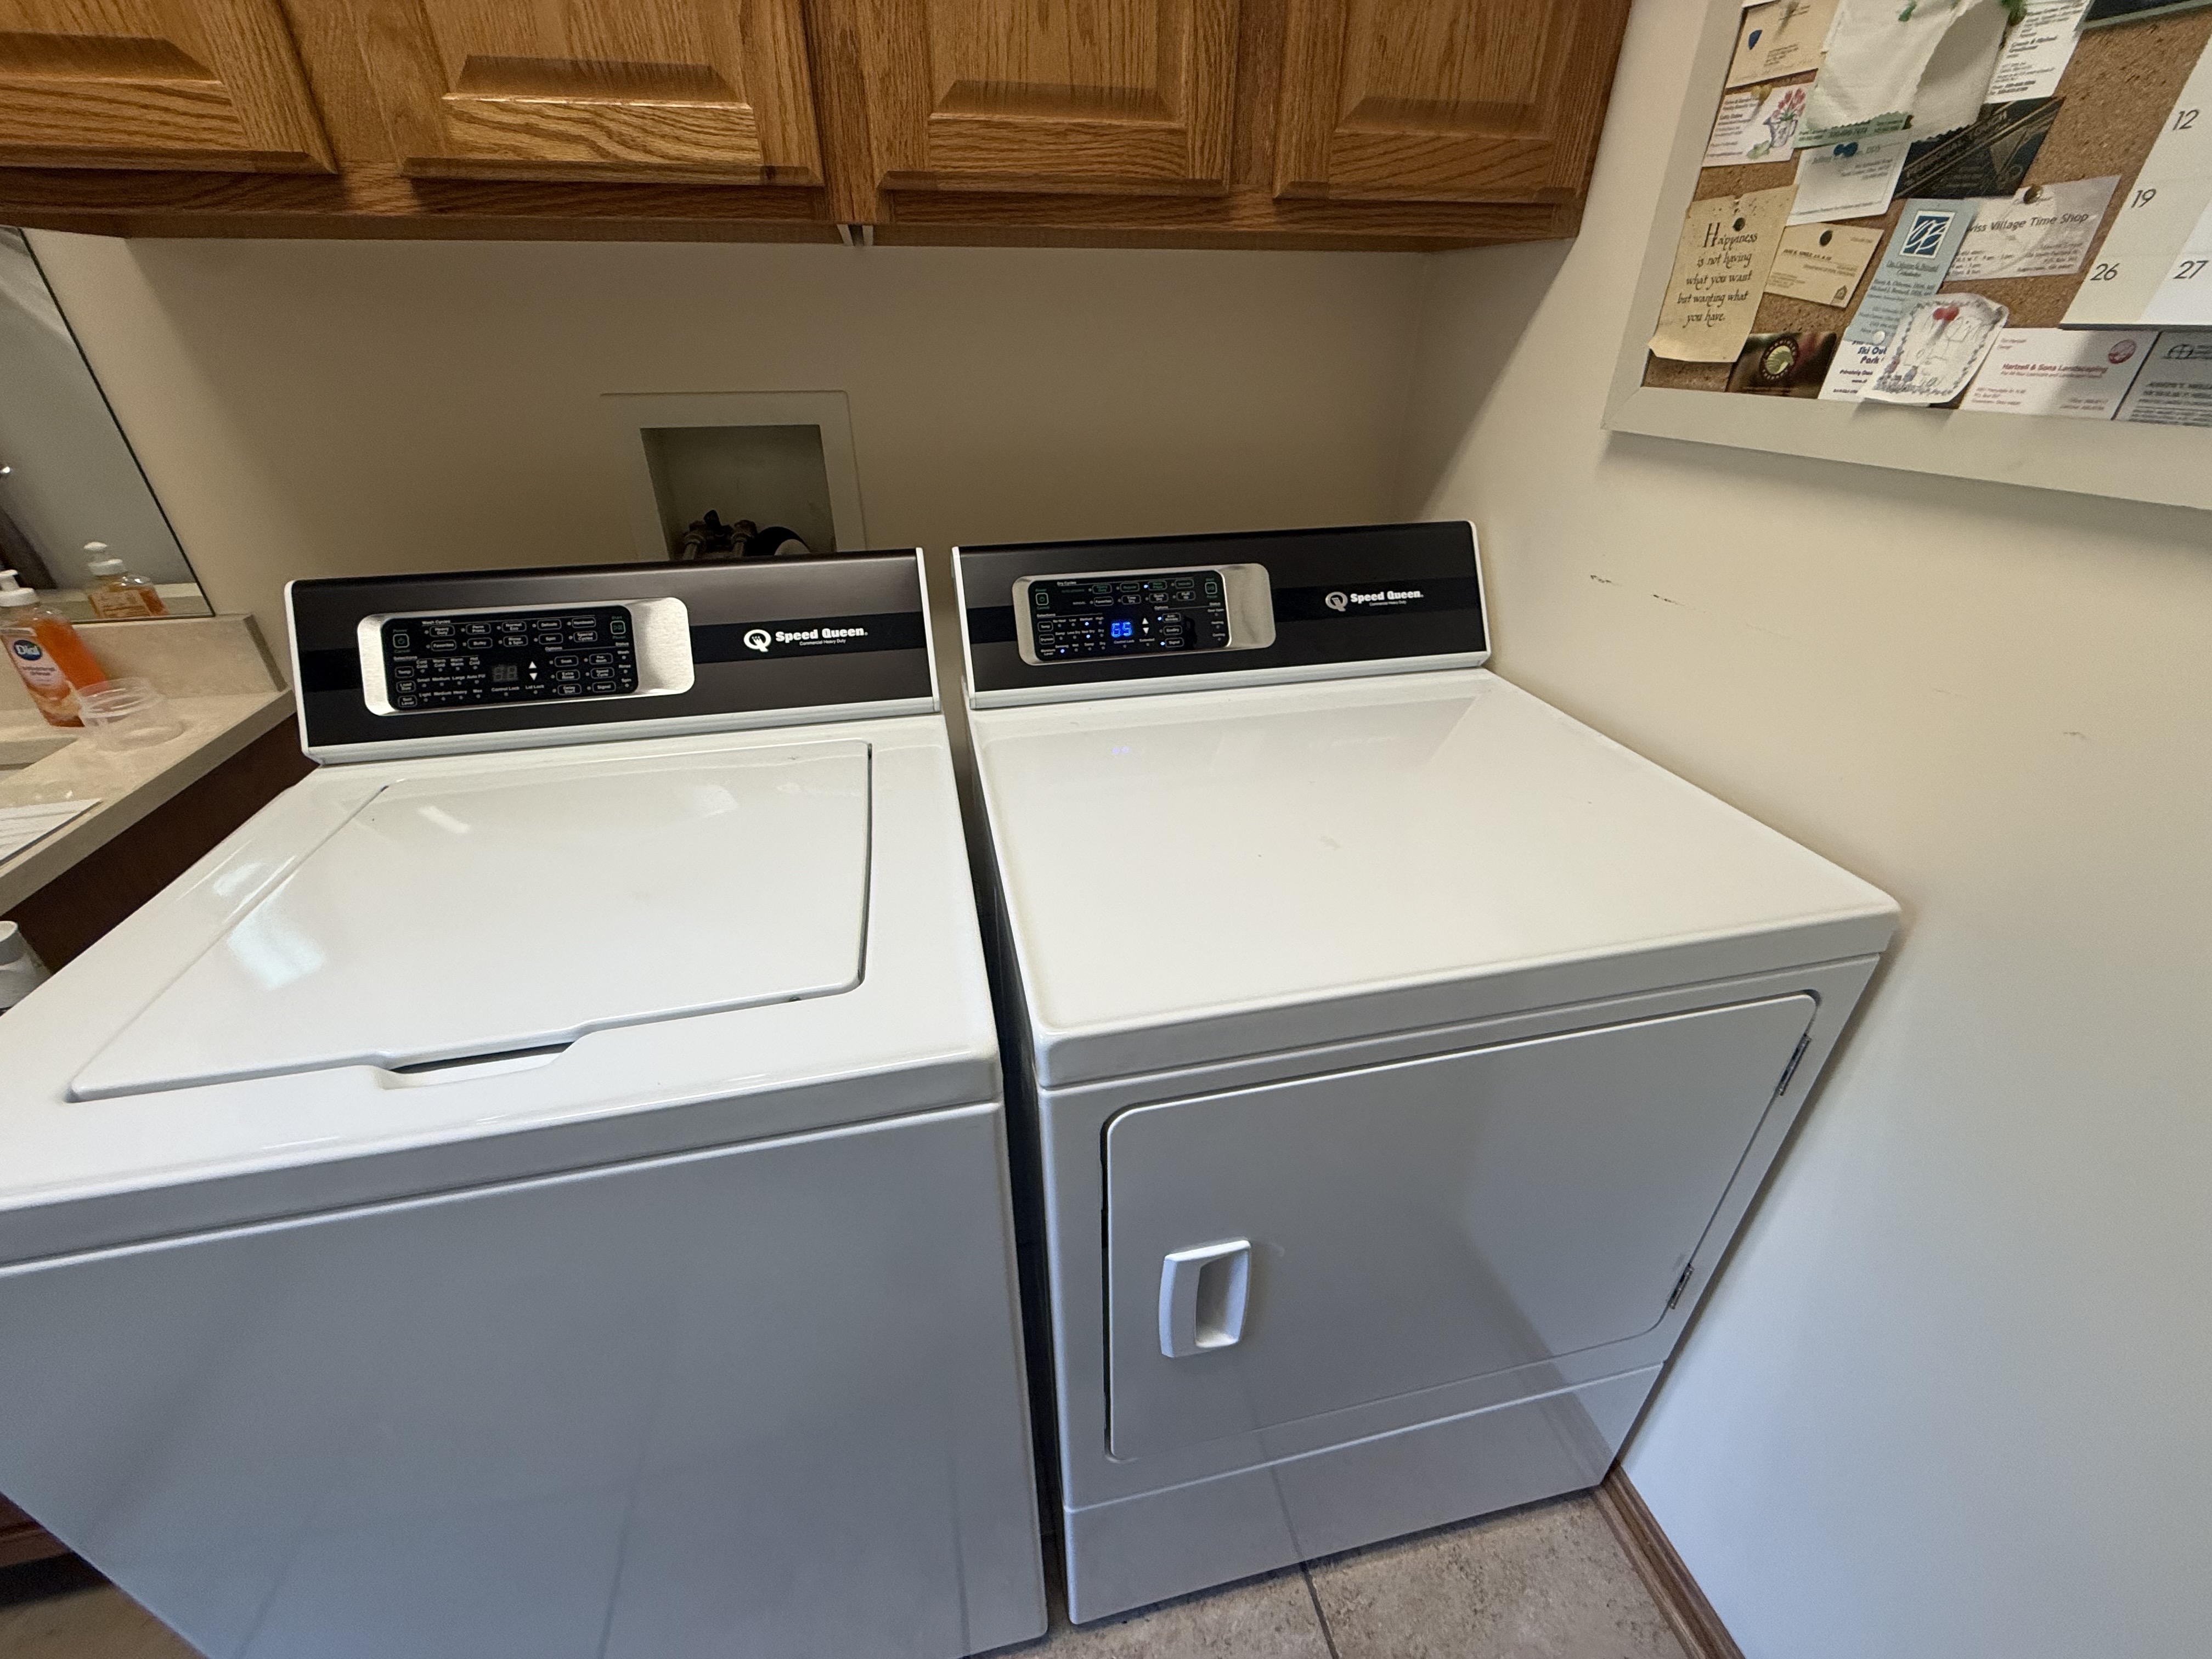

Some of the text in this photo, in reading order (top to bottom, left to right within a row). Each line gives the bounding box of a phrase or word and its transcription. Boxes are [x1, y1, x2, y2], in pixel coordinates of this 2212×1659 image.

[2172, 109, 2199, 131] 12
[2131, 188, 2157, 208] 19
[1991, 219, 2027, 231] Village
[2030, 216, 2057, 226] Time
[2061, 213, 2089, 224] Shop
[1702, 222, 1758, 251] Happiness
[1697, 252, 1753, 269] is not having
[2090, 260, 2209, 281] 26 27
[1686, 273, 1708, 290] what
[1706, 275, 1726, 290] you
[1729, 270, 1752, 282] want
[1677, 289, 1749, 307] but wanting what
[1682, 313, 1703, 328] you
[1857, 346, 1871, 354] Ski
[1860, 356, 1880, 364] Park
[2058, 365, 2108, 374] Landscaping
[1350, 591, 1385, 604] Speed
[1387, 590, 1421, 600] Queen
[775, 629, 819, 644] Speed
[822, 628, 865, 639] Queen
[1111, 622, 1132, 637] 65
[15, 645, 40, 655] Dial
